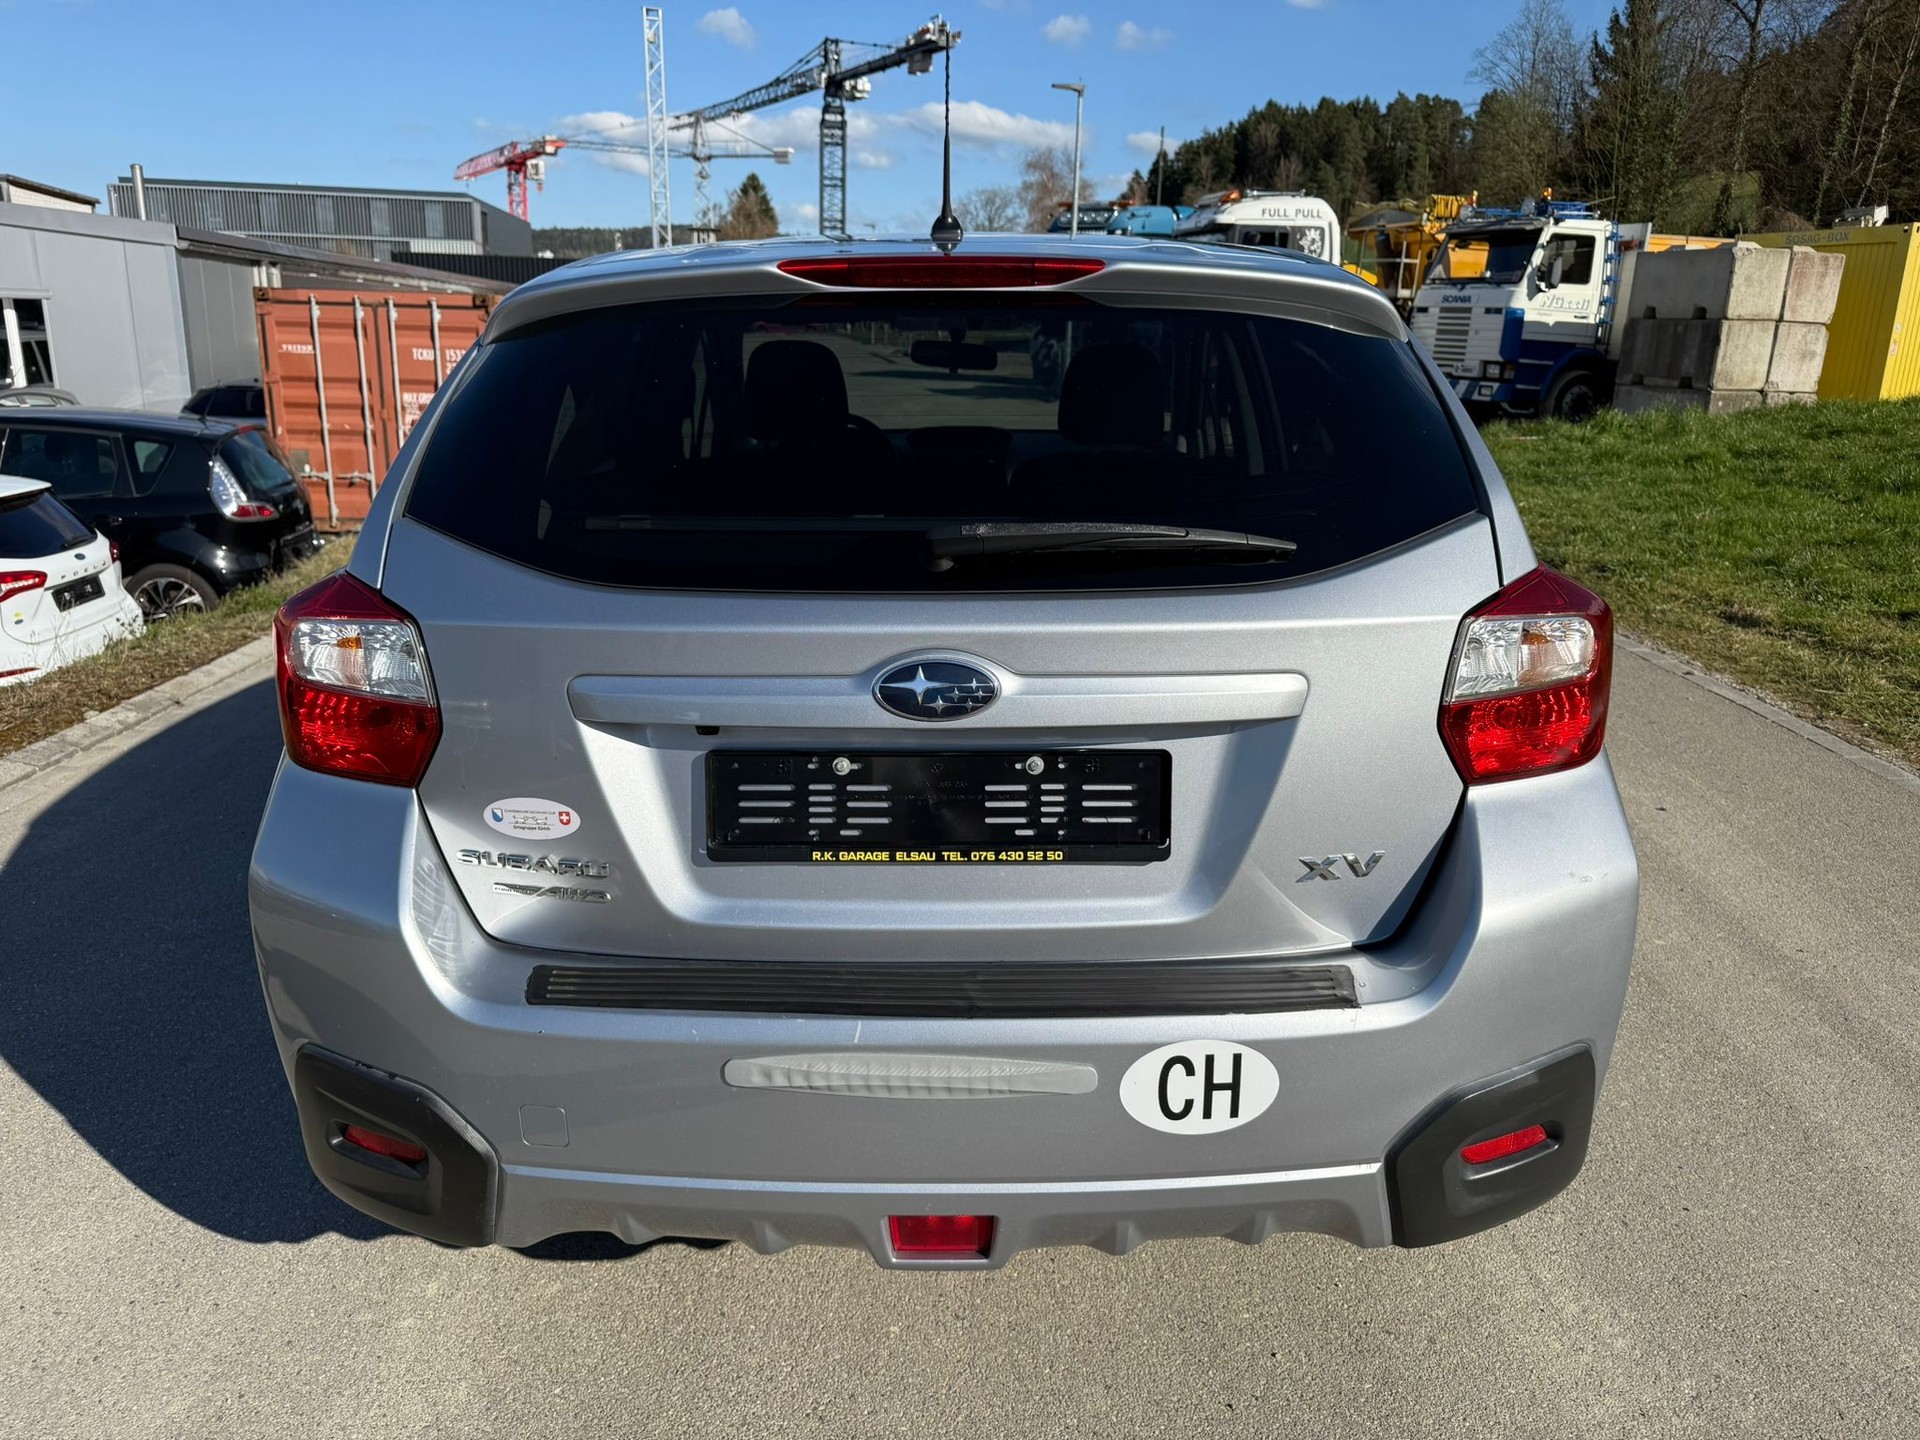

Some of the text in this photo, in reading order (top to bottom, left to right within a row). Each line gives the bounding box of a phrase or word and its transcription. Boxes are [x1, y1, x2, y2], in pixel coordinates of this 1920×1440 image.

[1261, 208, 1323, 219] FULL PULL
[1786, 232, 1850, 245] SOSAG-BOX
[1441, 295, 1472, 304] SCANIA
[812, 851, 1064, 861] R.K. GARAGE ELSAU TEL. 076 430 52 50
[456, 849, 610, 878] SUBARU
[1295, 850, 1386, 883] XV
[1158, 1053, 1242, 1121] CH
